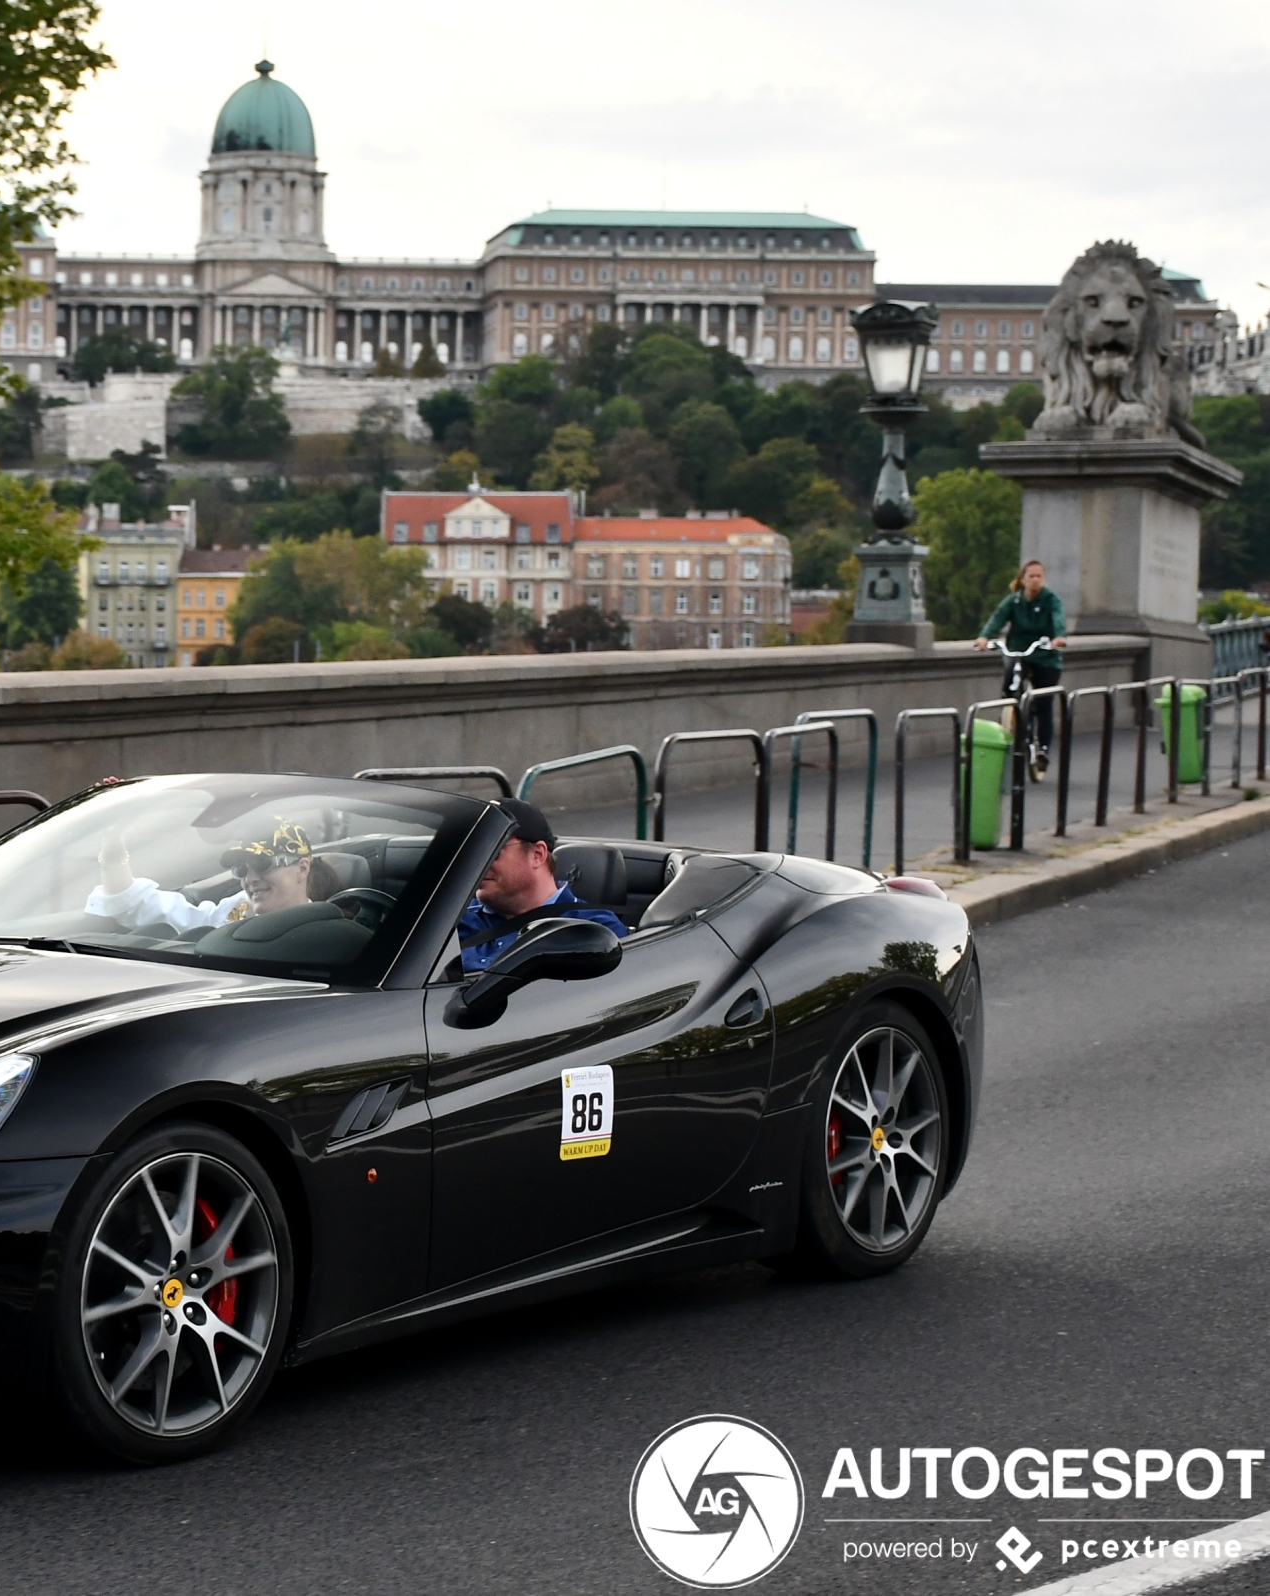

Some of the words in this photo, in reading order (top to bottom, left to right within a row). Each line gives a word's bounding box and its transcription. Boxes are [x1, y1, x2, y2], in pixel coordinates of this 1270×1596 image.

[571, 1092, 603, 1134] 86
[563, 1146, 583, 1156] WARM
[594, 1143, 607, 1153] DAY
